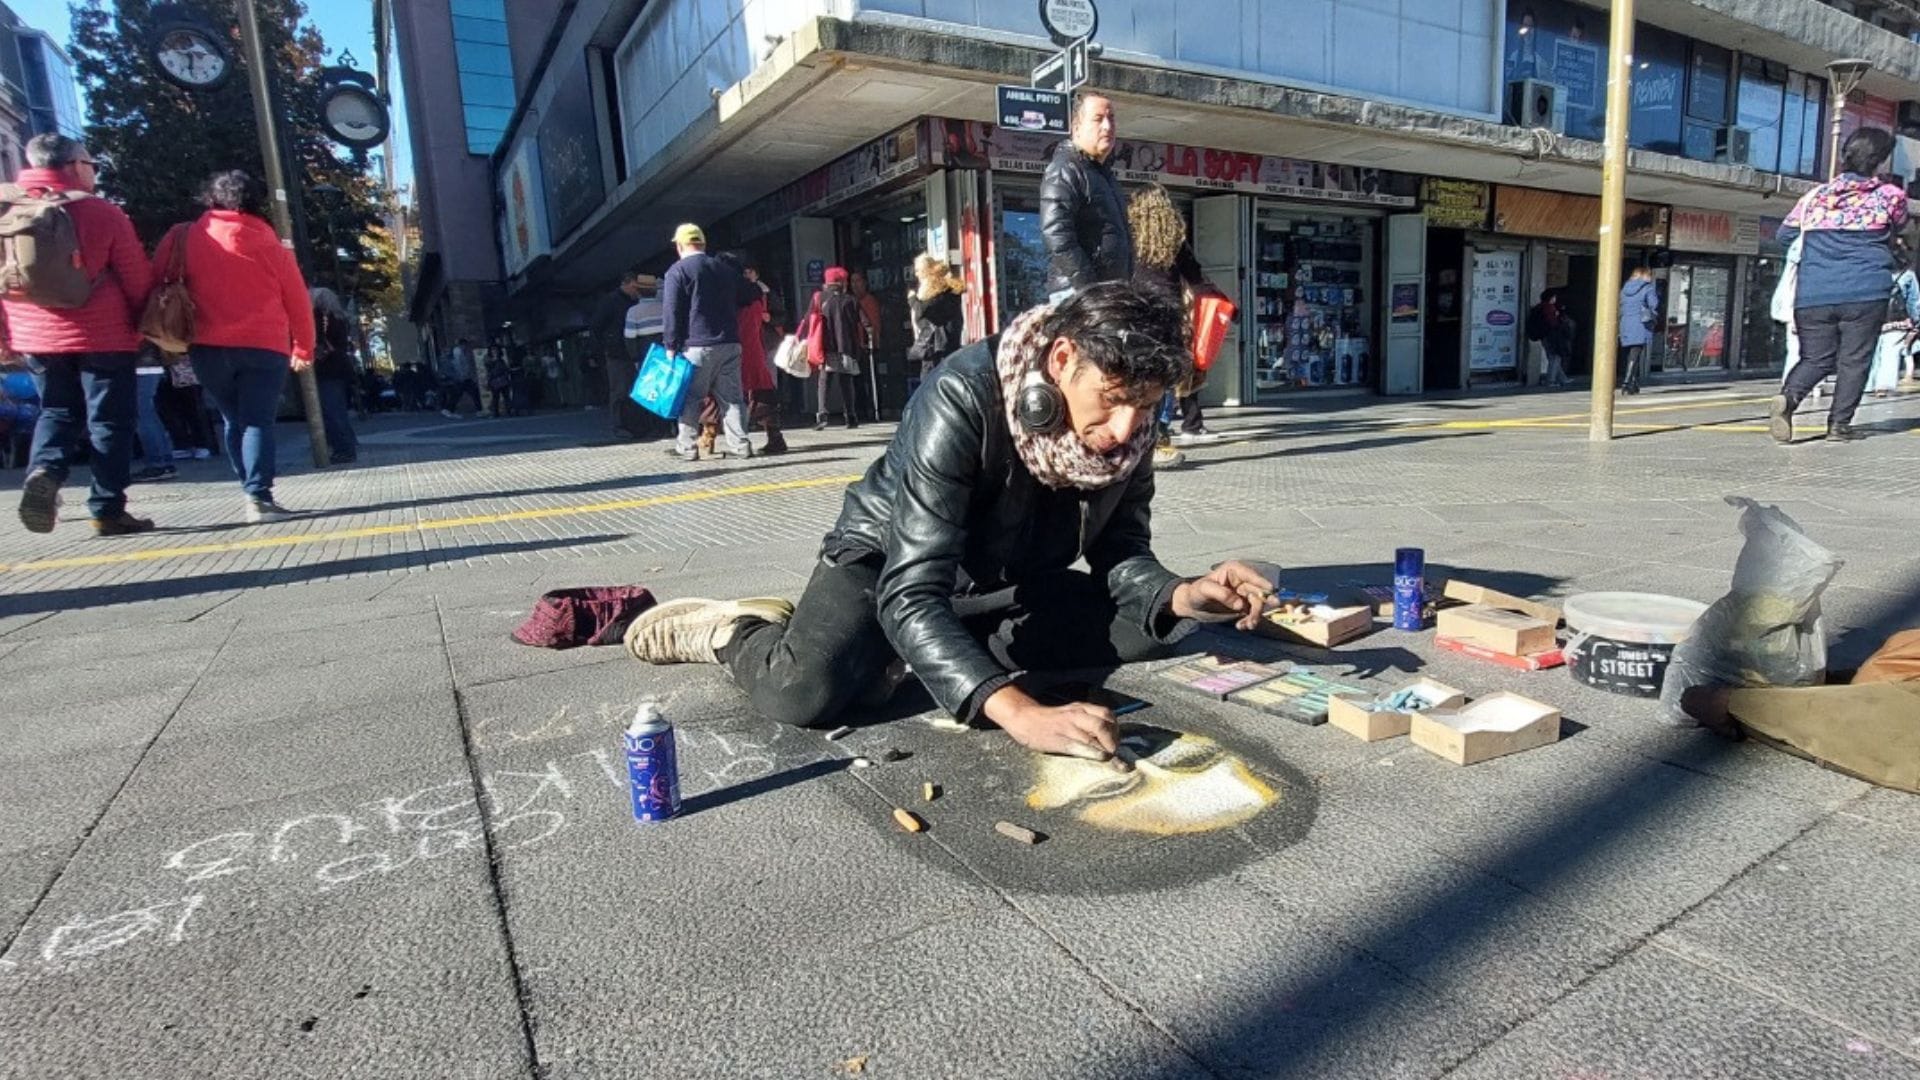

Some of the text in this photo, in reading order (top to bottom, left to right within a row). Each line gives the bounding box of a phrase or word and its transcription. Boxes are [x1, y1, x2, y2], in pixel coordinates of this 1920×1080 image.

[1166, 143, 1263, 185] LA SOFY
[1600, 658, 1655, 678] STREET
